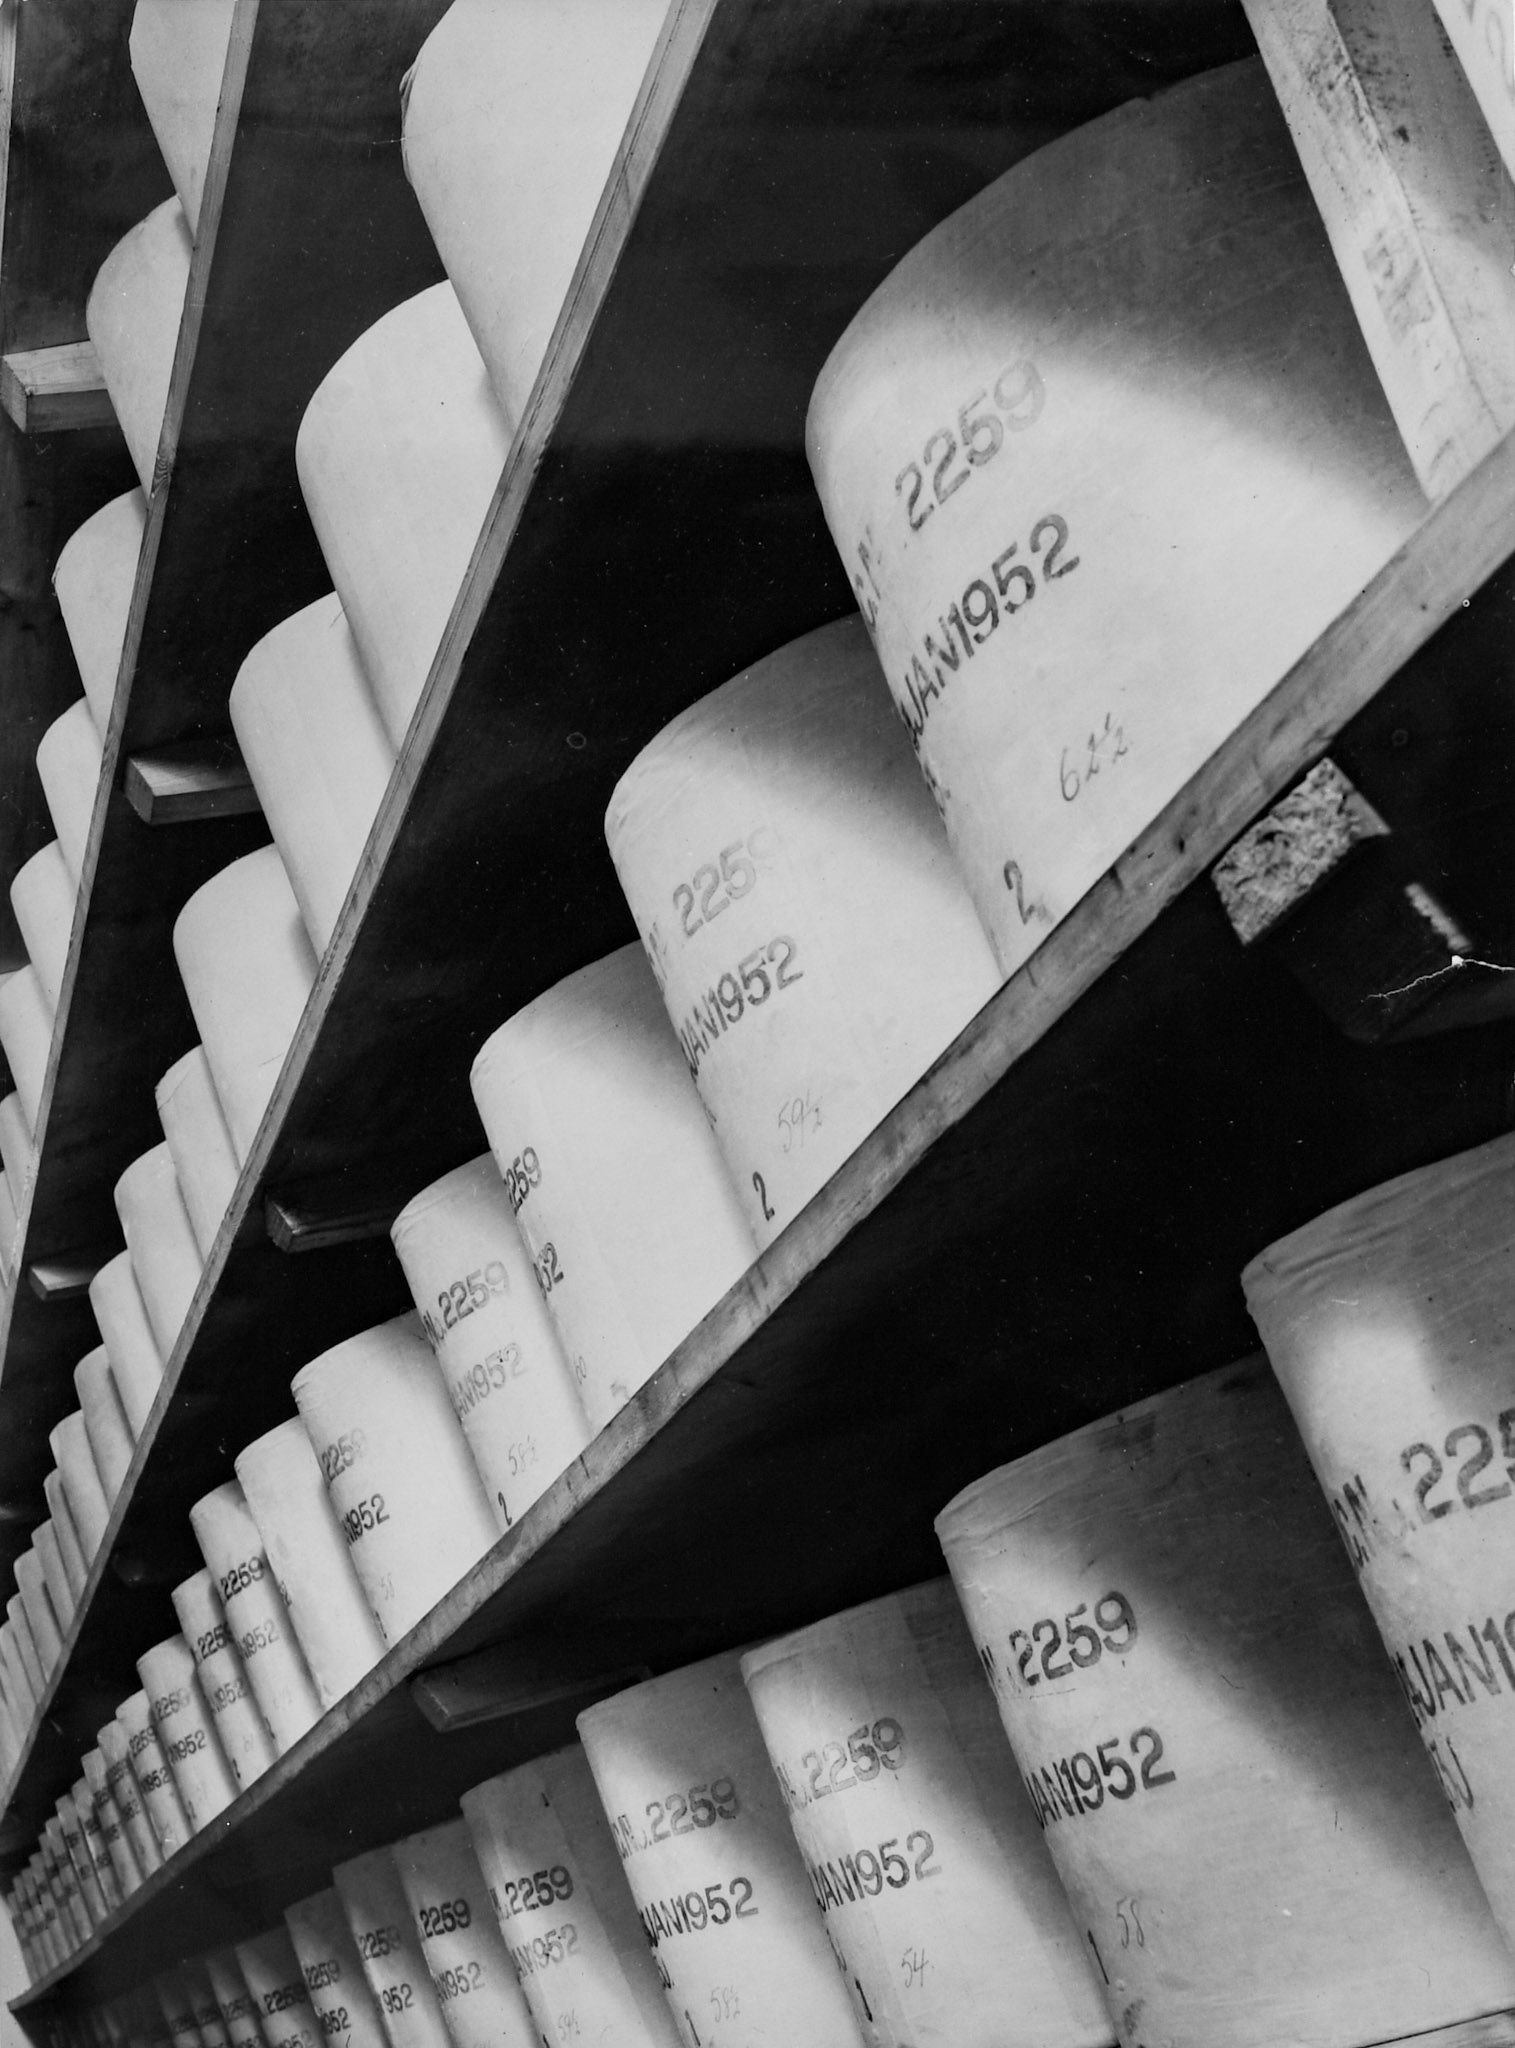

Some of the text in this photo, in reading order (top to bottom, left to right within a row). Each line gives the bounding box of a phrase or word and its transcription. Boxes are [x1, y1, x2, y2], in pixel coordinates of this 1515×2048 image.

[894, 360, 1046, 532] 2259
[752, 1171, 775, 1221] 2
[438, 1261, 510, 1330] 2259
[220, 1556, 265, 1601] 2259
[1008, 1591, 1139, 1686] 2259
[1408, 1611, 1515, 1717] JAN1
[802, 1717, 908, 1800] 2259
[645, 1775, 741, 1843] 2259
[419, 1898, 472, 1938] 2259
[504, 1865, 574, 1916] 2259
